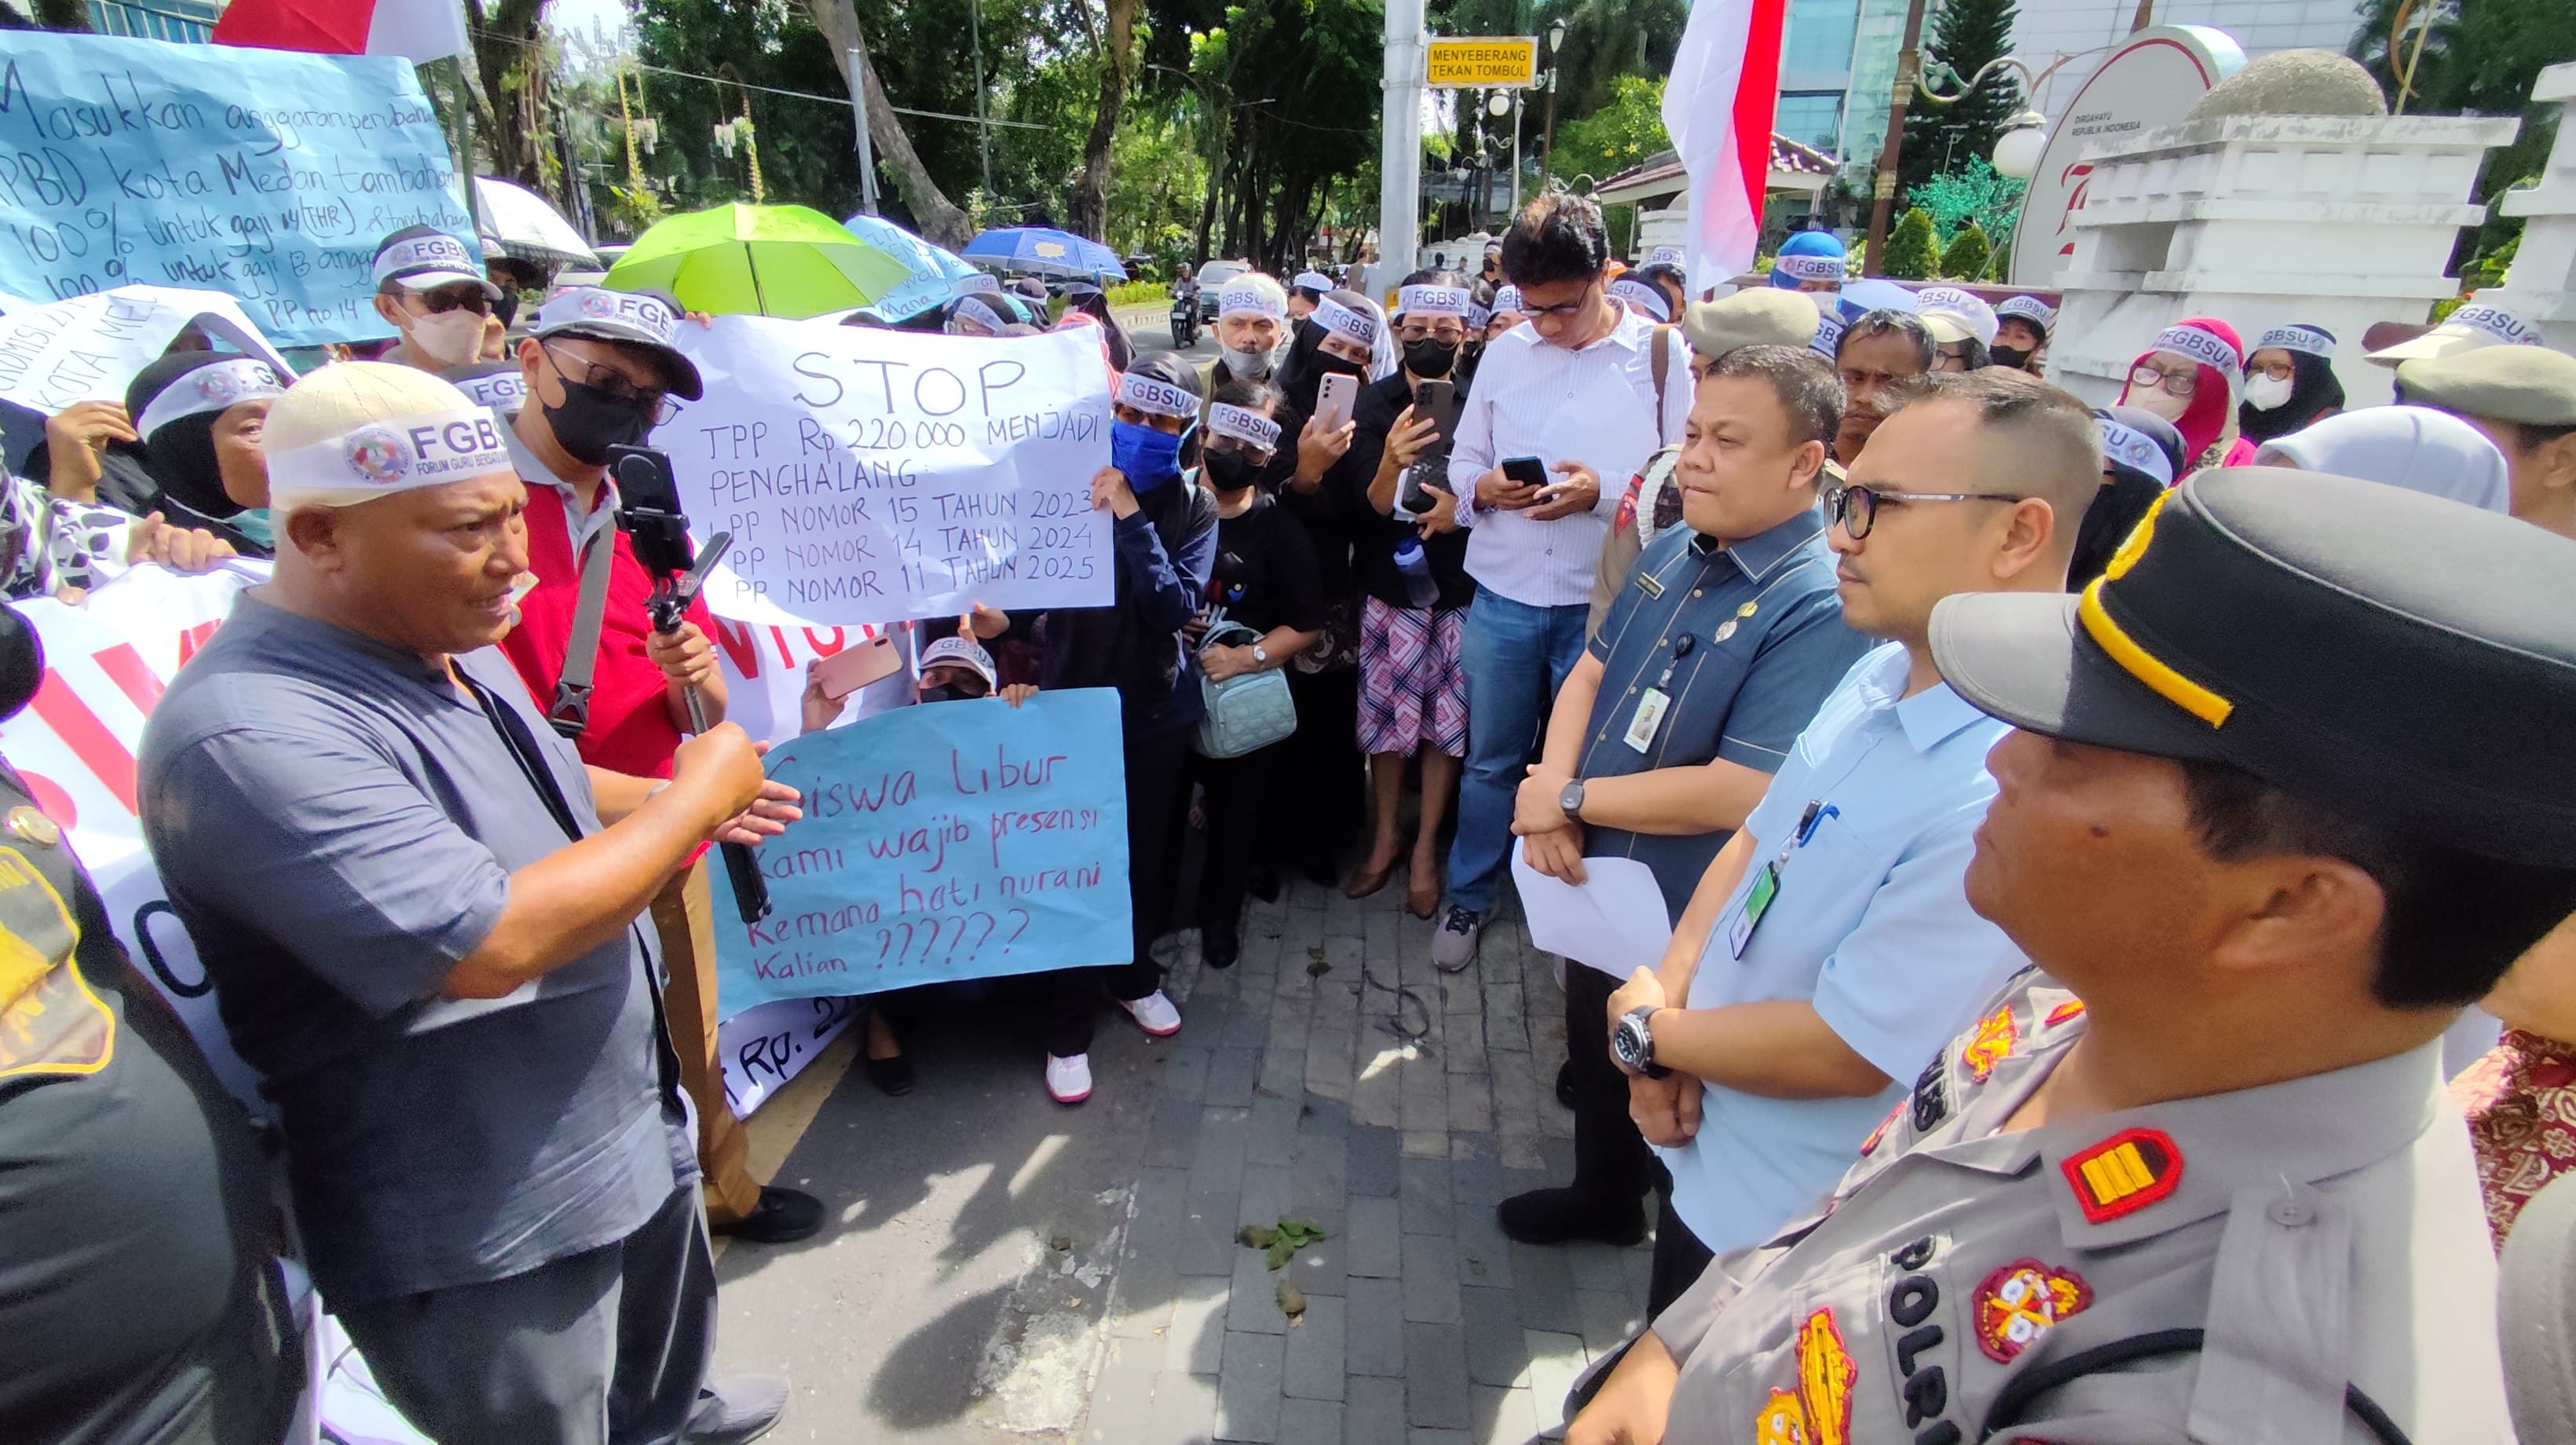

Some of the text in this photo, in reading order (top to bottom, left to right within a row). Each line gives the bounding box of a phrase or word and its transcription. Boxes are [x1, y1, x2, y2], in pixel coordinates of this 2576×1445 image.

[1432, 64, 1526, 77] TEKAN TOMBOL
[1433, 50, 1527, 63] MENYEBERANG
[0, 59, 204, 141] Masukkan
[225, 104, 344, 156] anggaran
[2071, 120, 2141, 136] REPUBLIK INDONESIA
[2074, 112, 2113, 124] DIRGAHAYU
[0, 146, 86, 207] PBD
[216, 150, 327, 195] Medan
[333, 153, 456, 194] tambahan
[229, 210, 273, 258] gaji
[242, 258, 279, 300] gaji
[1796, 260, 1843, 273] FGBSU
[264, 299, 299, 328] PP
[1414, 290, 1464, 306] FGBSU
[1330, 309, 1376, 338] FGBSU
[2161, 331, 2228, 364] FGBSU
[29, 349, 119, 409] KOTA
[792, 352, 1026, 418] STOP
[701, 421, 768, 459] TPP
[987, 404, 1099, 445] MENJADI
[1219, 407, 1272, 437] FGBSU
[415, 459, 450, 476] FORUM
[781, 496, 871, 536] NOMOR
[887, 496, 918, 525] 15
[932, 492, 1017, 522] TAHUN
[1030, 488, 1092, 520] 2023
[734, 525, 1092, 576] PP NOMOR 14 TAHUN 2024
[736, 554, 1095, 605] PP NOMOR 11 TAHUN 2025
[868, 814, 970, 873] wajib
[990, 807, 1099, 869] presensi
[899, 872, 979, 916] hati
[999, 860, 1101, 898] nurani
